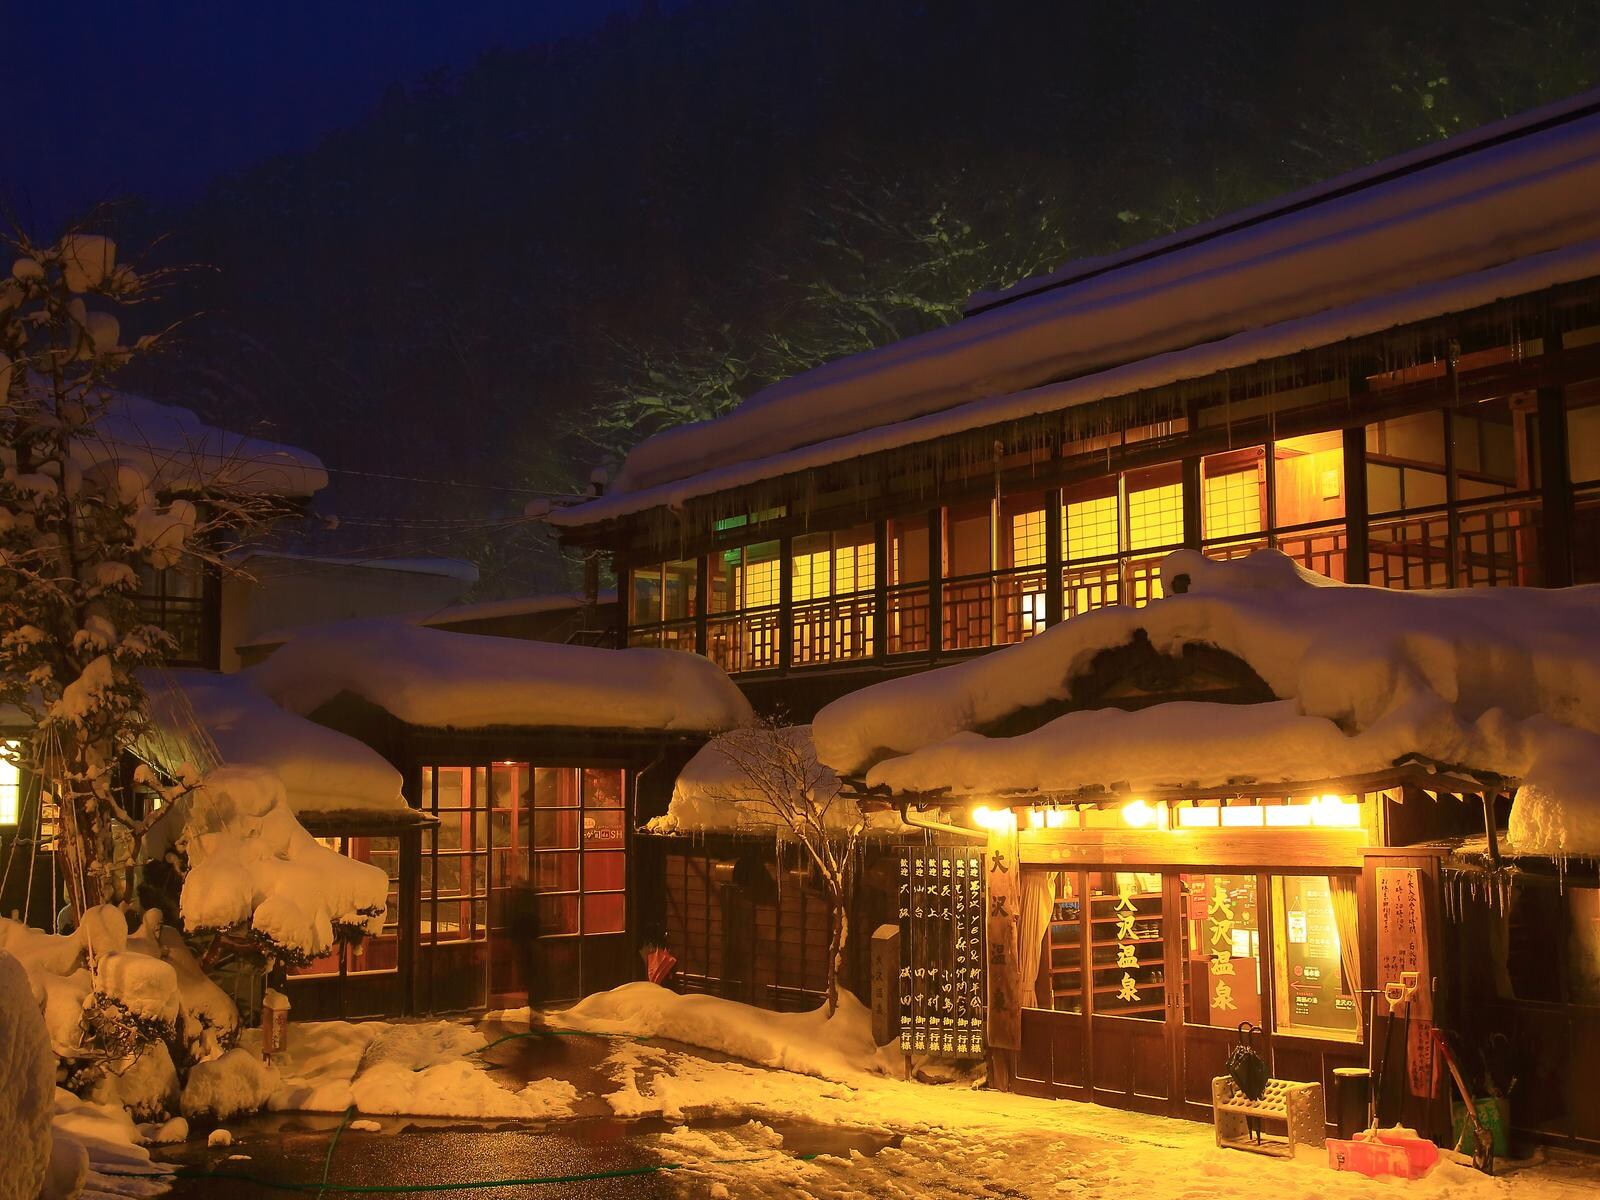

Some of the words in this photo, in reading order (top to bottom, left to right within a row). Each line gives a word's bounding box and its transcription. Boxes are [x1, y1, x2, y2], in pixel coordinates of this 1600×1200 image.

[927, 884, 939, 918] 北上
[990, 849, 1009, 1013] 大沢温泉
[1114, 880, 1141, 1002] 大沢温泉
[1207, 883, 1238, 1011] 大沢温泉
[914, 967, 925, 1007] 田中
[927, 967, 939, 1011] 中村
[900, 1015, 911, 1050] 御一行様
[914, 1015, 926, 1050] 御一行様
[929, 1016, 940, 1051] 御一行様
[942, 1017, 954, 1052] 御一行様
[957, 1018, 969, 1053] 御一行様
[970, 1018, 982, 1053] 御一行様
